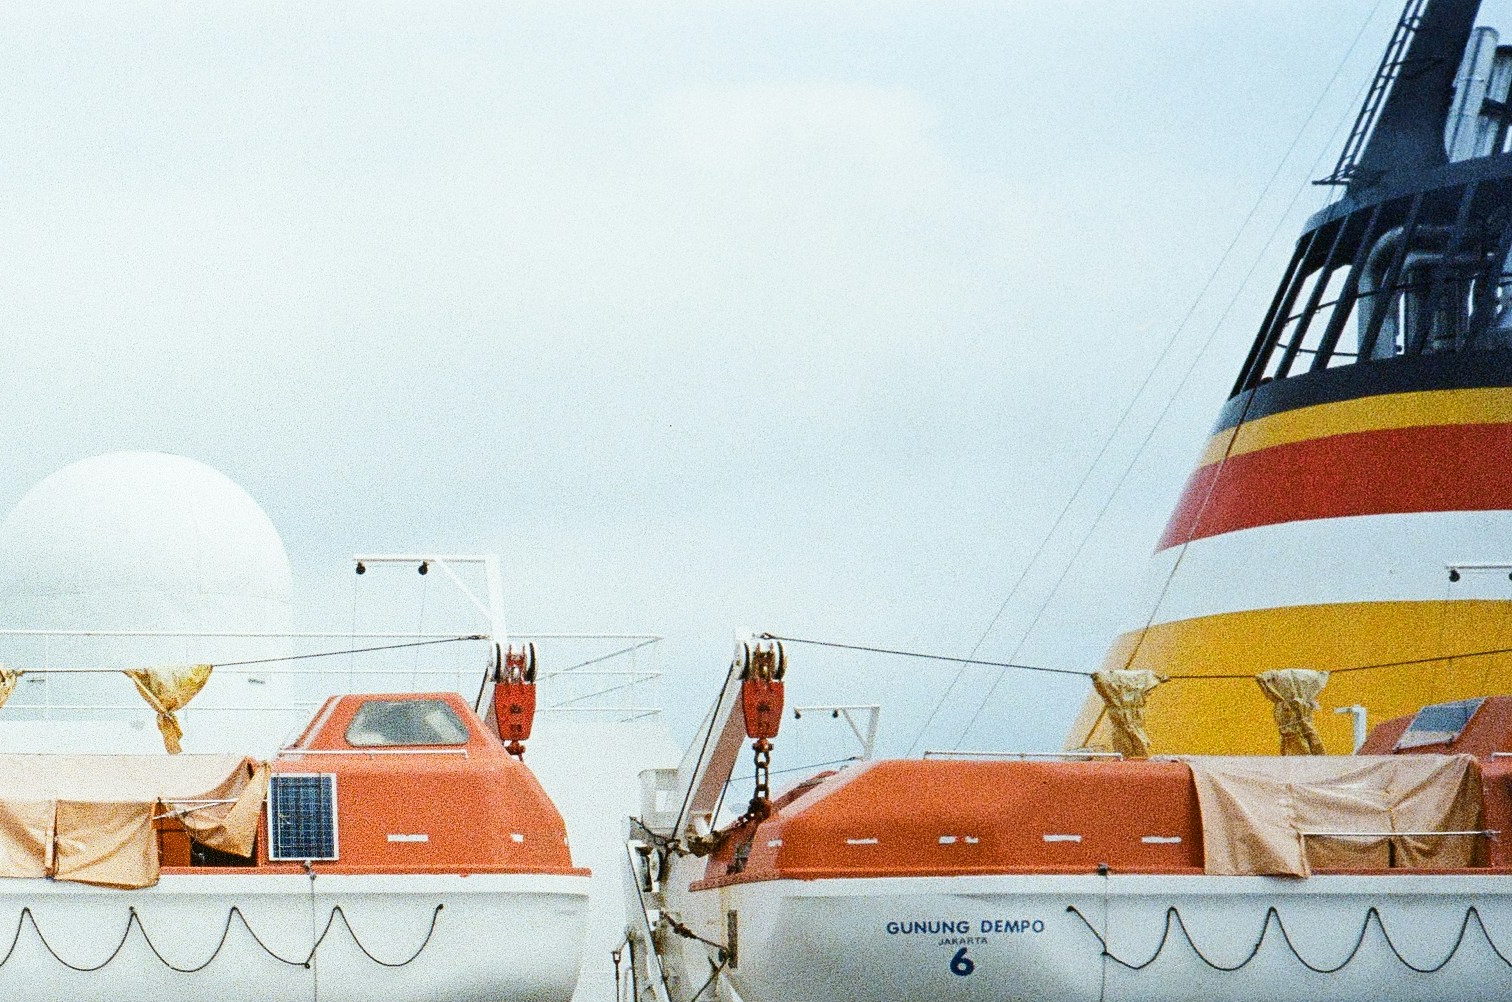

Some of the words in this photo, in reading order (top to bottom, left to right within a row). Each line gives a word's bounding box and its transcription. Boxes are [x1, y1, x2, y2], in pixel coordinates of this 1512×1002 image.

[886, 920, 970, 935] GUNUNG
[980, 919, 1045, 934] DEMPO
[938, 936, 988, 946] JAKARTA
[949, 947, 975, 977] 6
